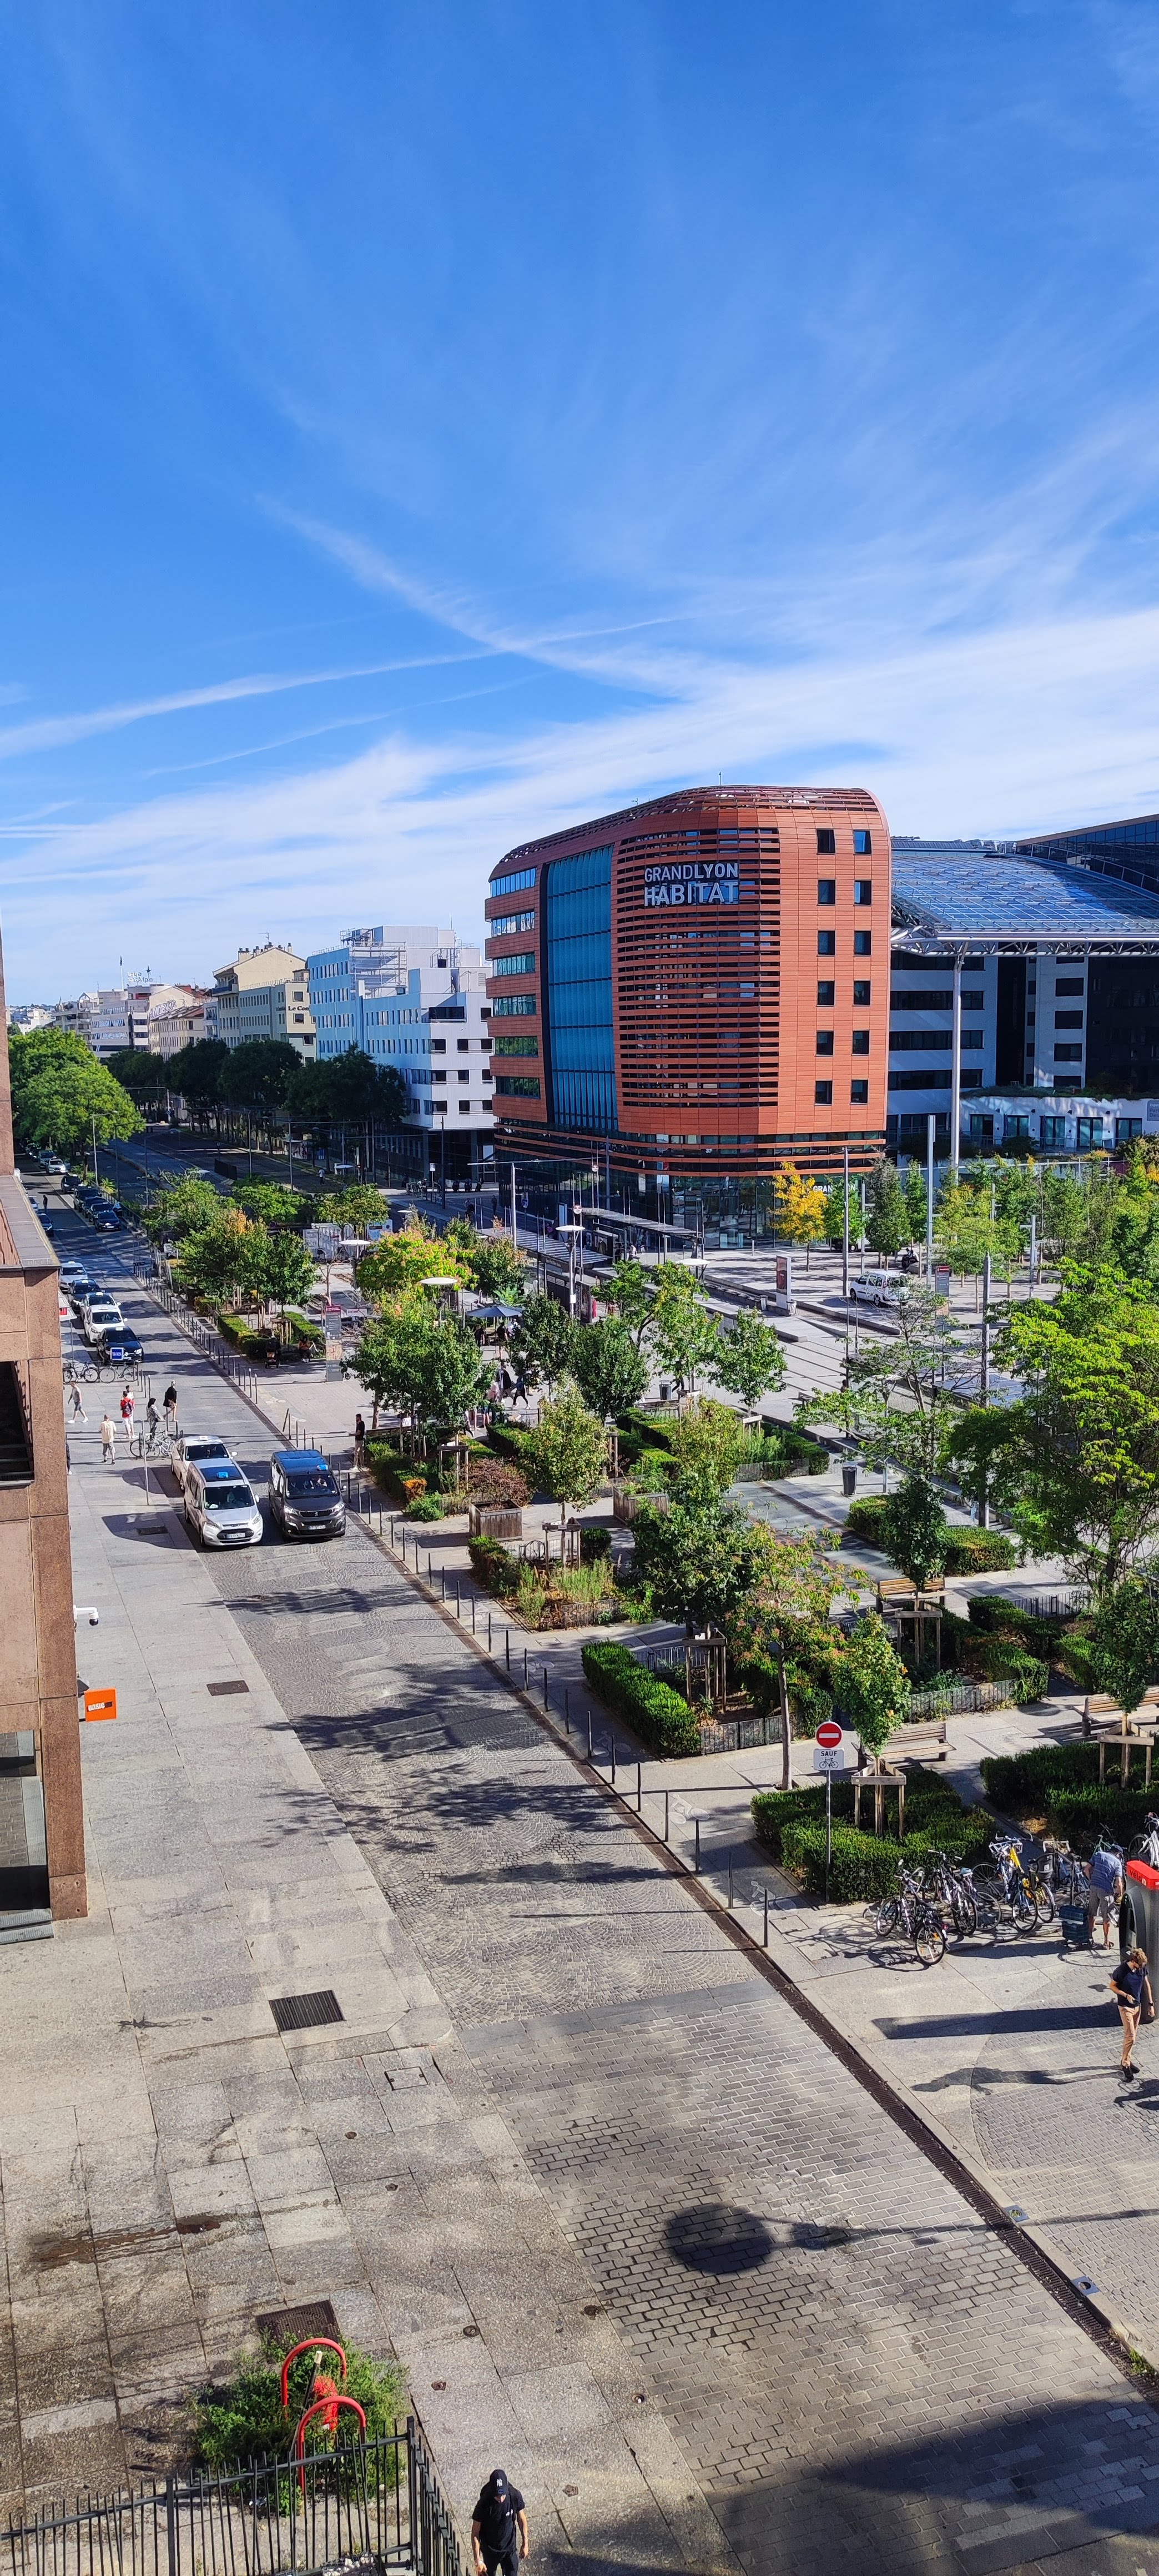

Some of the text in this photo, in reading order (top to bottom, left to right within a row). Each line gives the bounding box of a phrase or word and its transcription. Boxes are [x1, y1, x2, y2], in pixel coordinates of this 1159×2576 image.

[644, 863, 738, 883] GRANDLYON
[644, 882, 738, 907] HABITAT
[88, 1702, 105, 1712] BASIC
